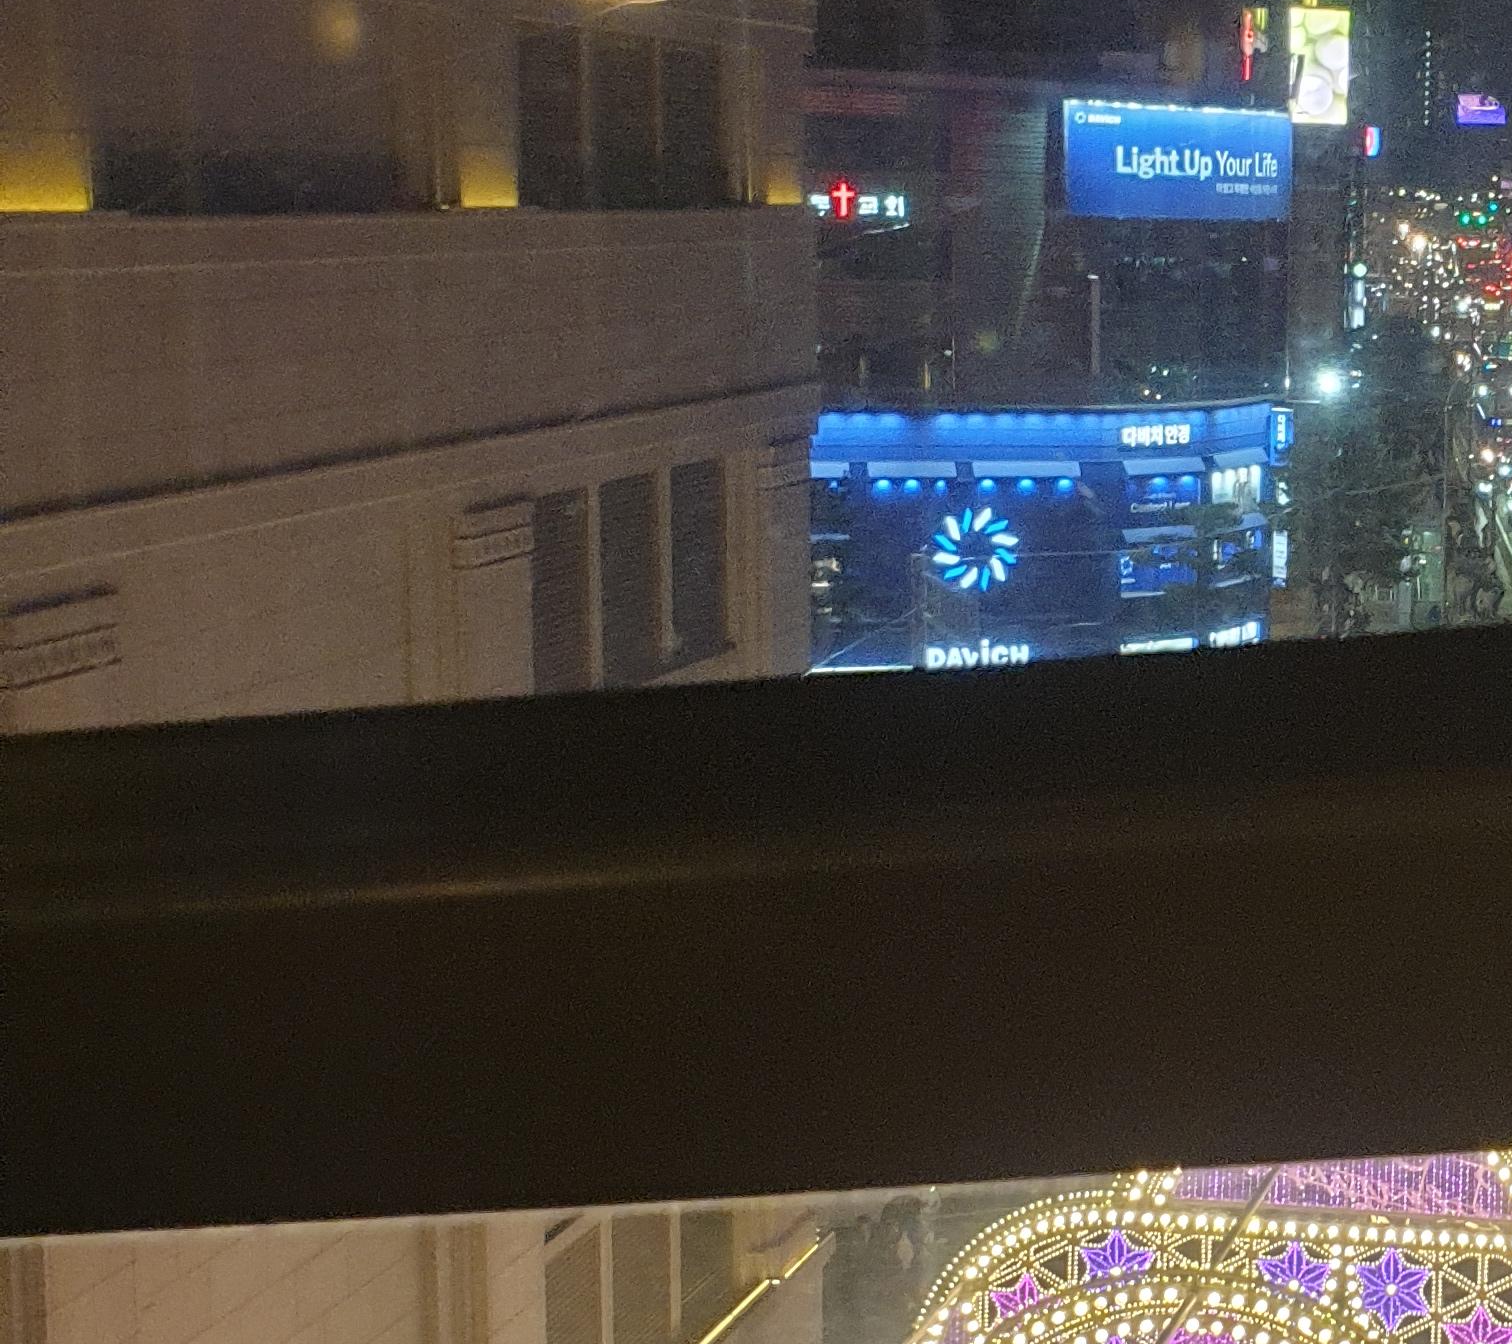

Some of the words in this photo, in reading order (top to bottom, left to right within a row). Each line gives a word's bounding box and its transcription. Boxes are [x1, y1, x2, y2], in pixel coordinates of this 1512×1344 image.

[1115, 145, 1180, 179] Light
[1183, 148, 1213, 181] Up
[1215, 149, 1253, 177] Your
[1254, 151, 1279, 178] Life
